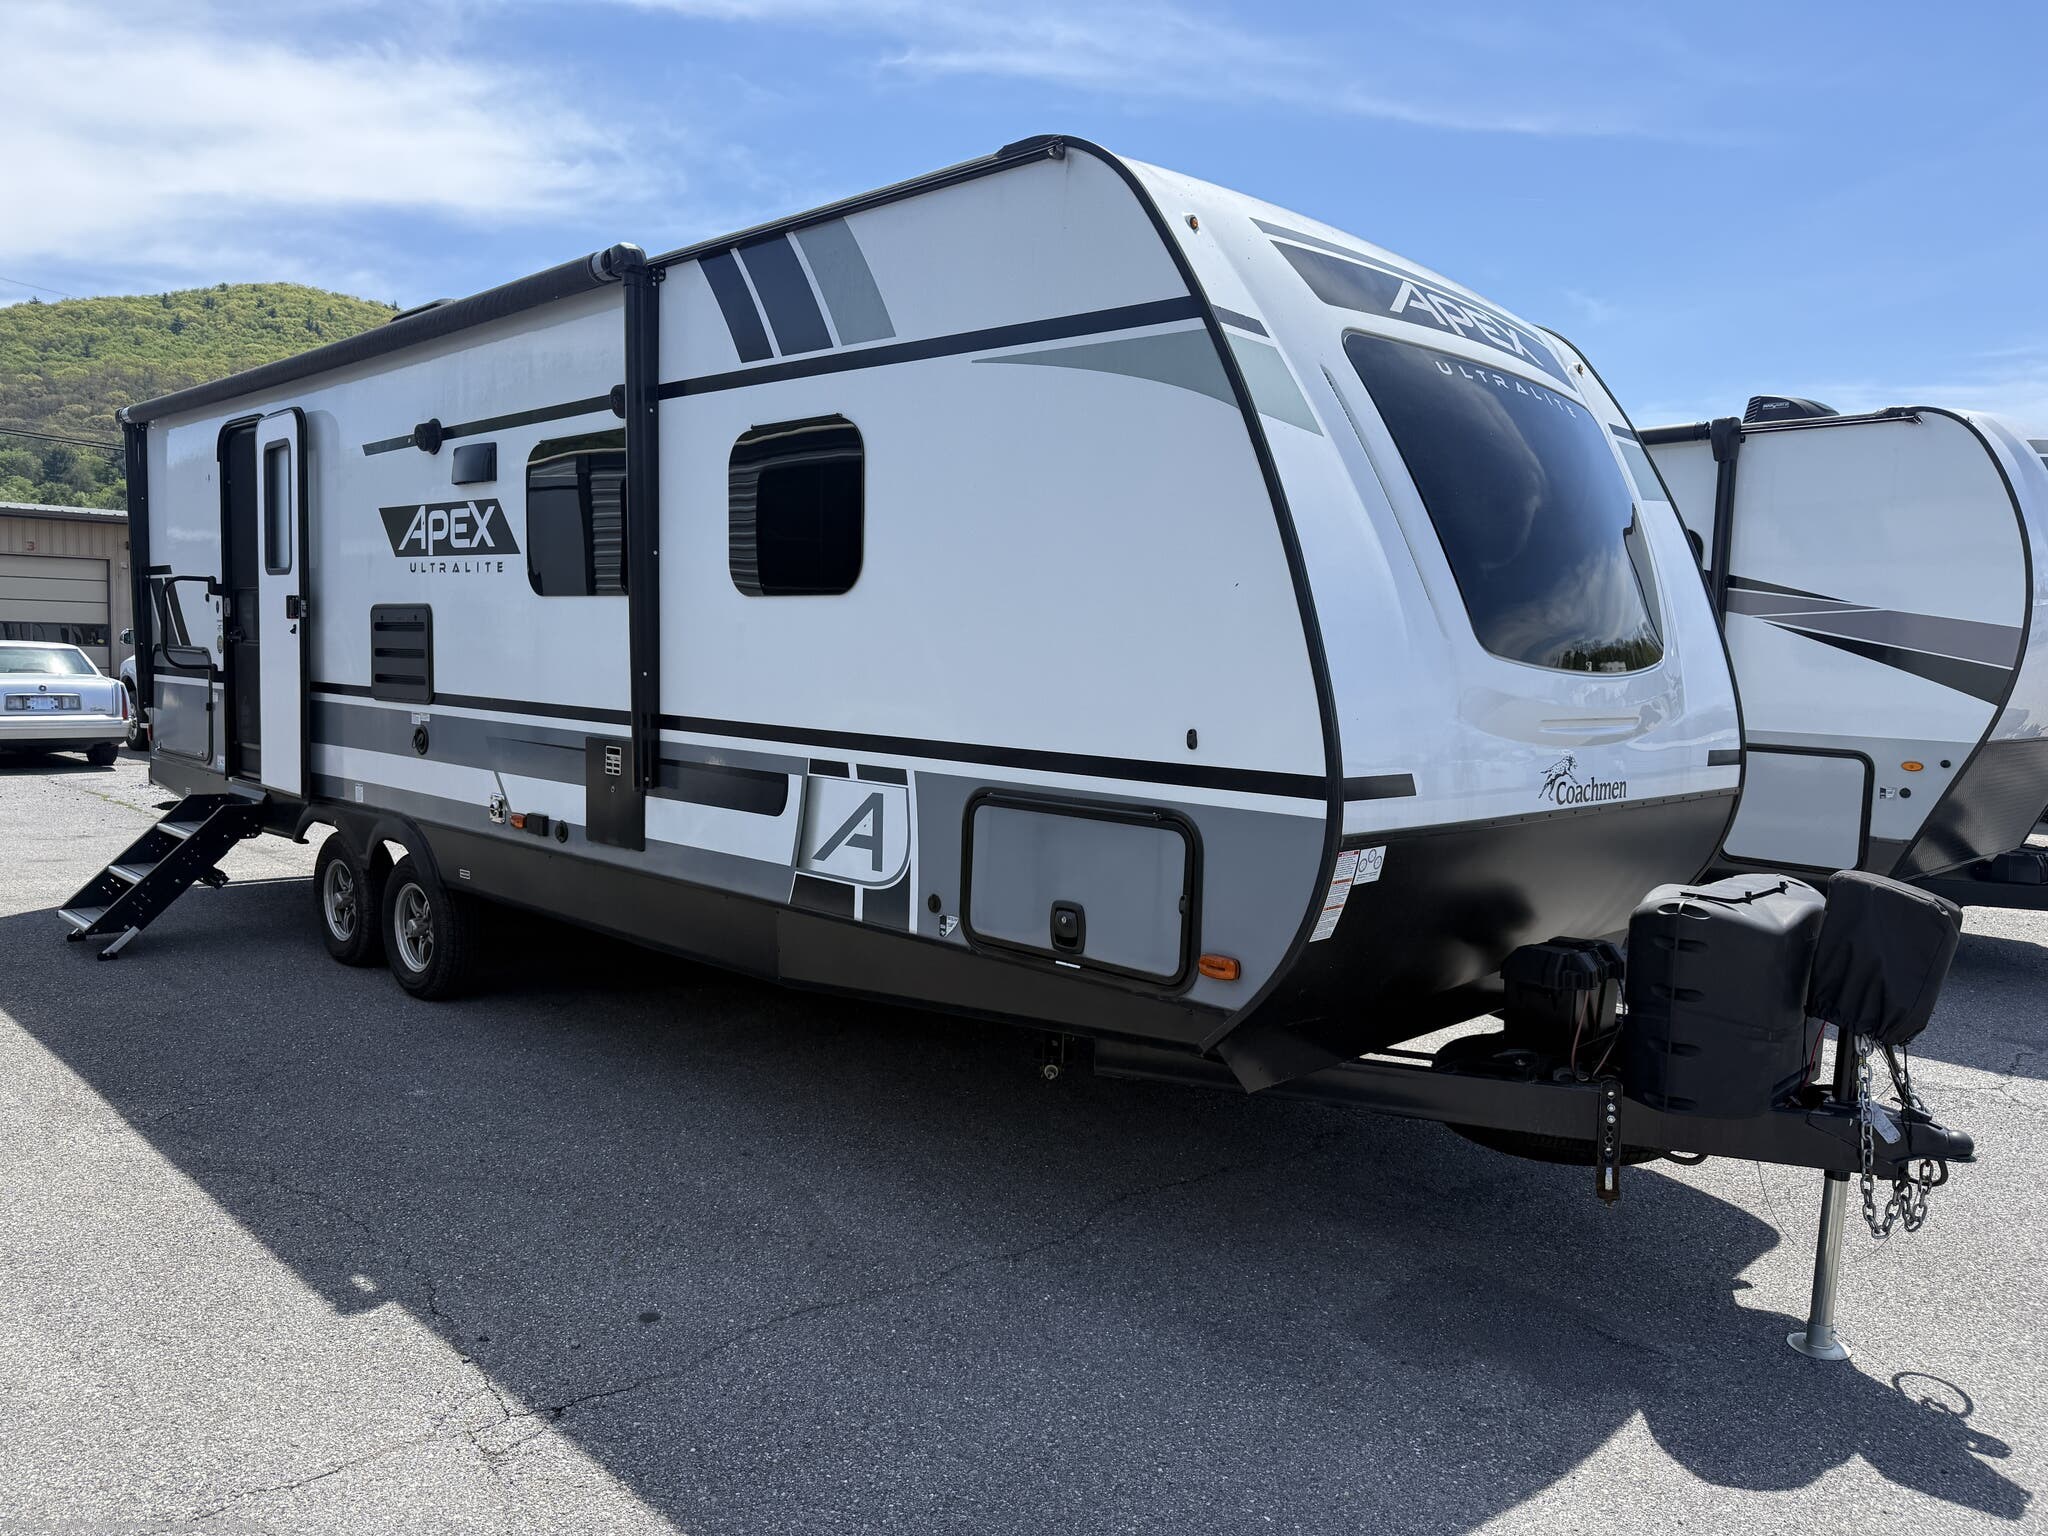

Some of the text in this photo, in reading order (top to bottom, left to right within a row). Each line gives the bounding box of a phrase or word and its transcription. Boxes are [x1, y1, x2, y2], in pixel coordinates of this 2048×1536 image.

[1389, 280, 1544, 368] APEX
[1435, 361, 1577, 419] ULTRALITE
[398, 501, 496, 556] APEX
[409, 562, 504, 573] ULTRALITE
[1556, 776, 1627, 805] Coachmen
[811, 792, 884, 873] A
